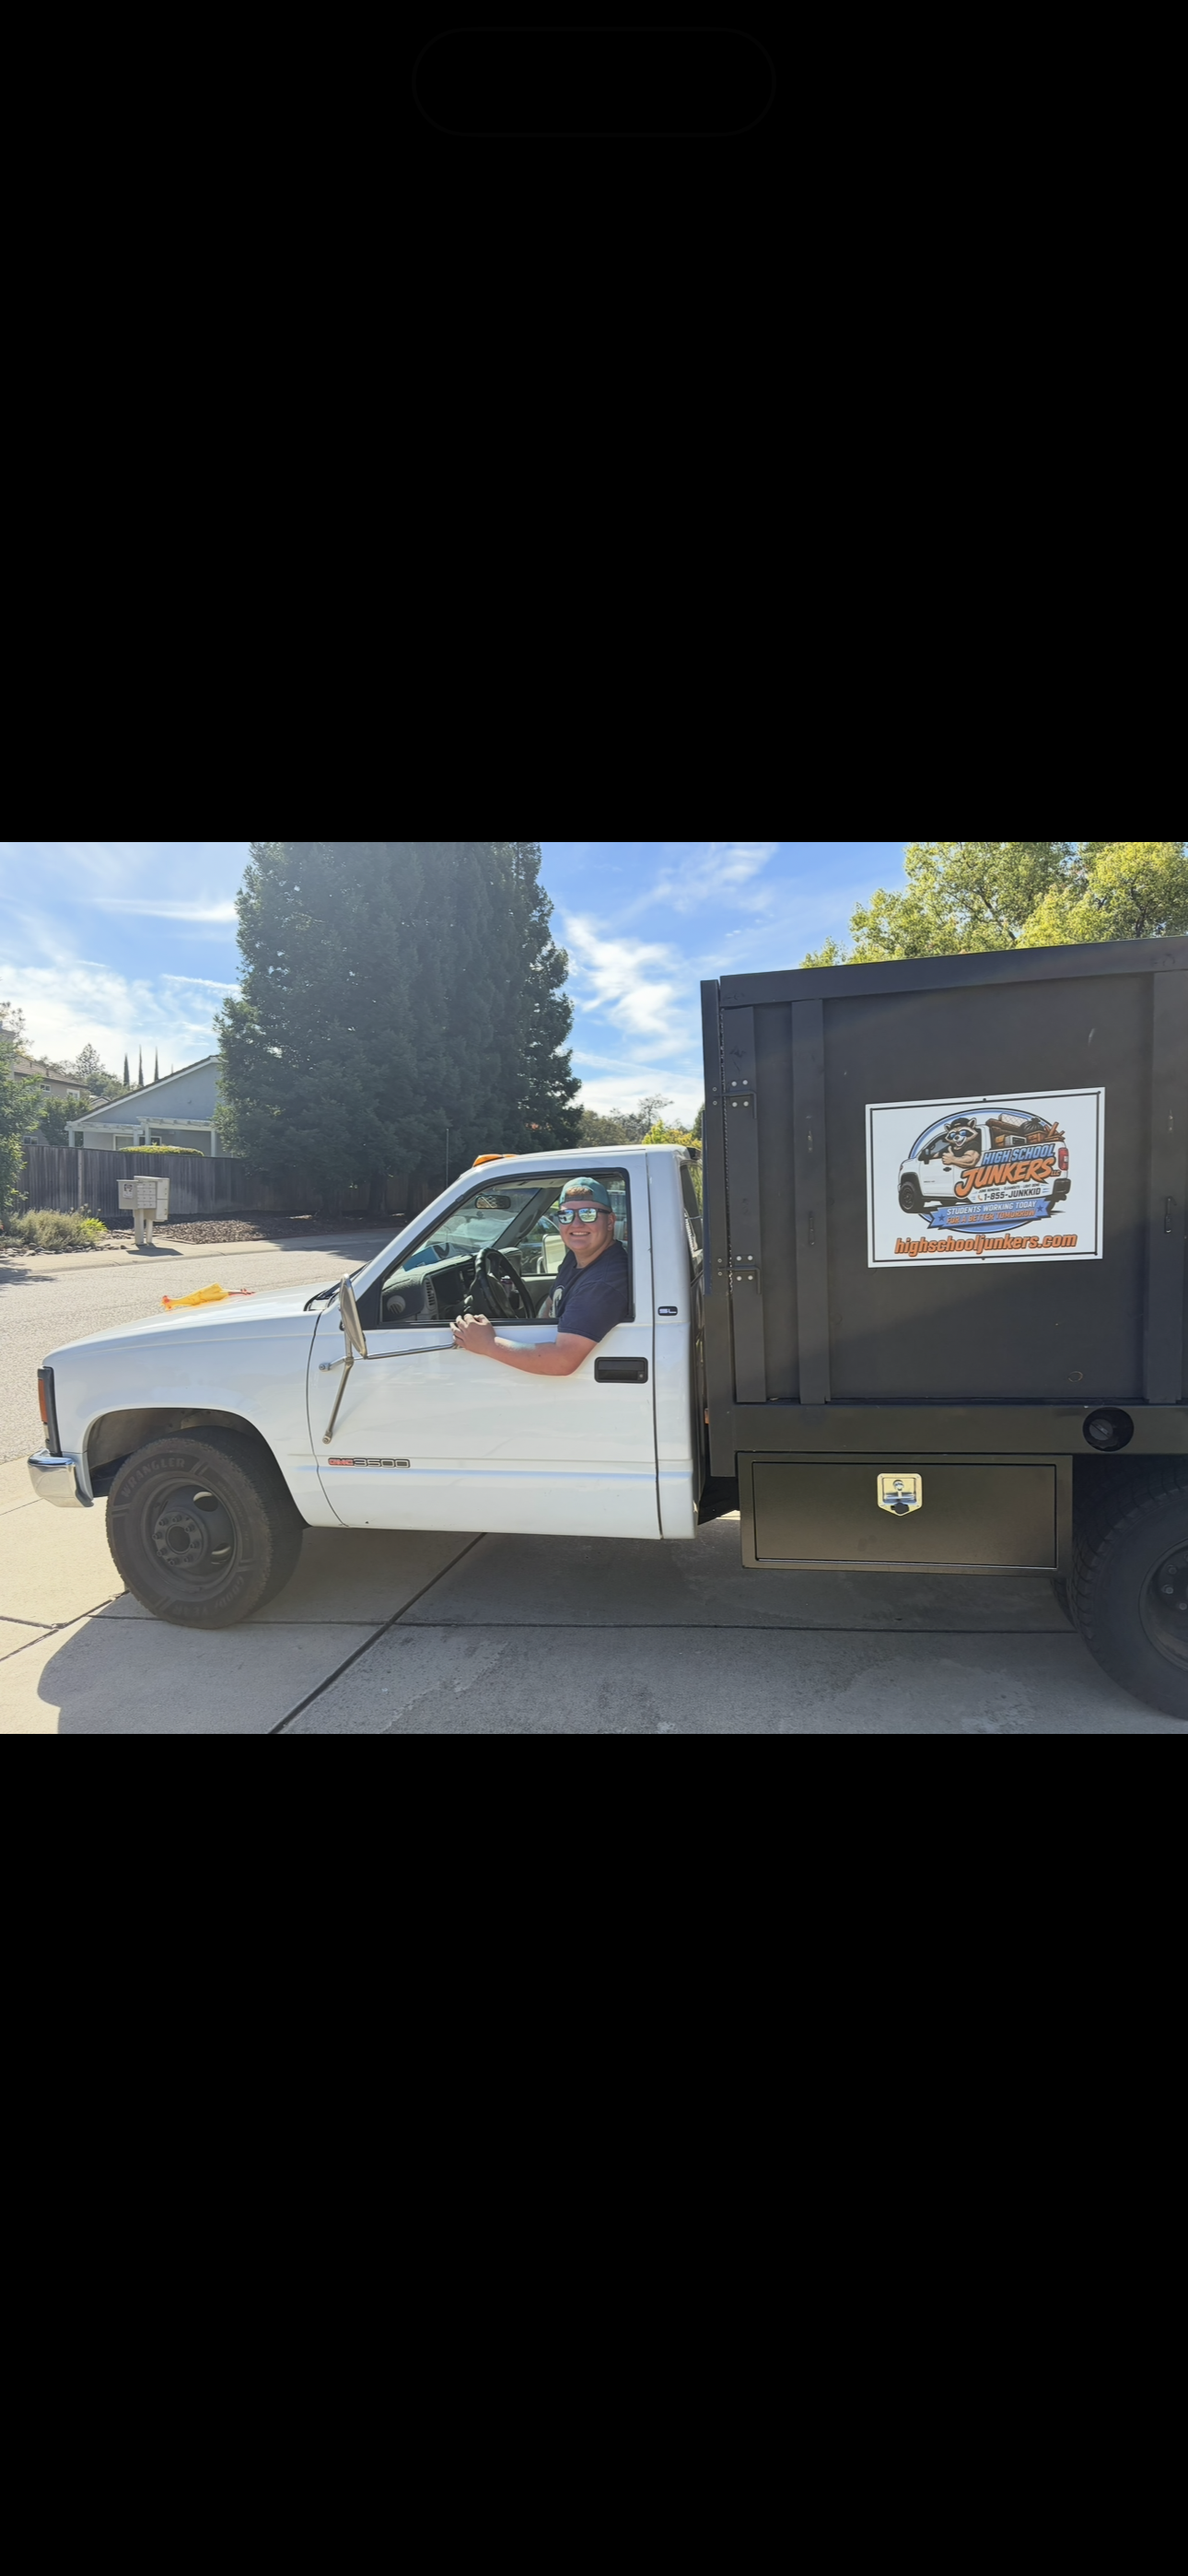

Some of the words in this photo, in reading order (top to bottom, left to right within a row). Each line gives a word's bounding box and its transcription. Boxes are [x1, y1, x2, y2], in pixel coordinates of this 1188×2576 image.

[982, 1149, 1012, 1166] HIGH
[1012, 1142, 1056, 1162] SCHOOL
[954, 1156, 1056, 1199] JUNKERS
[984, 1188, 1042, 1200] 1-855-JUNKKID
[946, 1216, 961, 1224] FOR
[961, 1215, 967, 1224] A
[968, 1213, 995, 1223] BETTER
[996, 1209, 1036, 1220] TOMORROW
[947, 1205, 982, 1215] STUDENTS
[983, 1202, 1014, 1212] WORKING
[1015, 1200, 1037, 1209] TODAY
[894, 1233, 1078, 1258] highschooljunkers.com
[354, 1458, 411, 1468] 3500
[121, 1458, 185, 1497] WRANGLER
